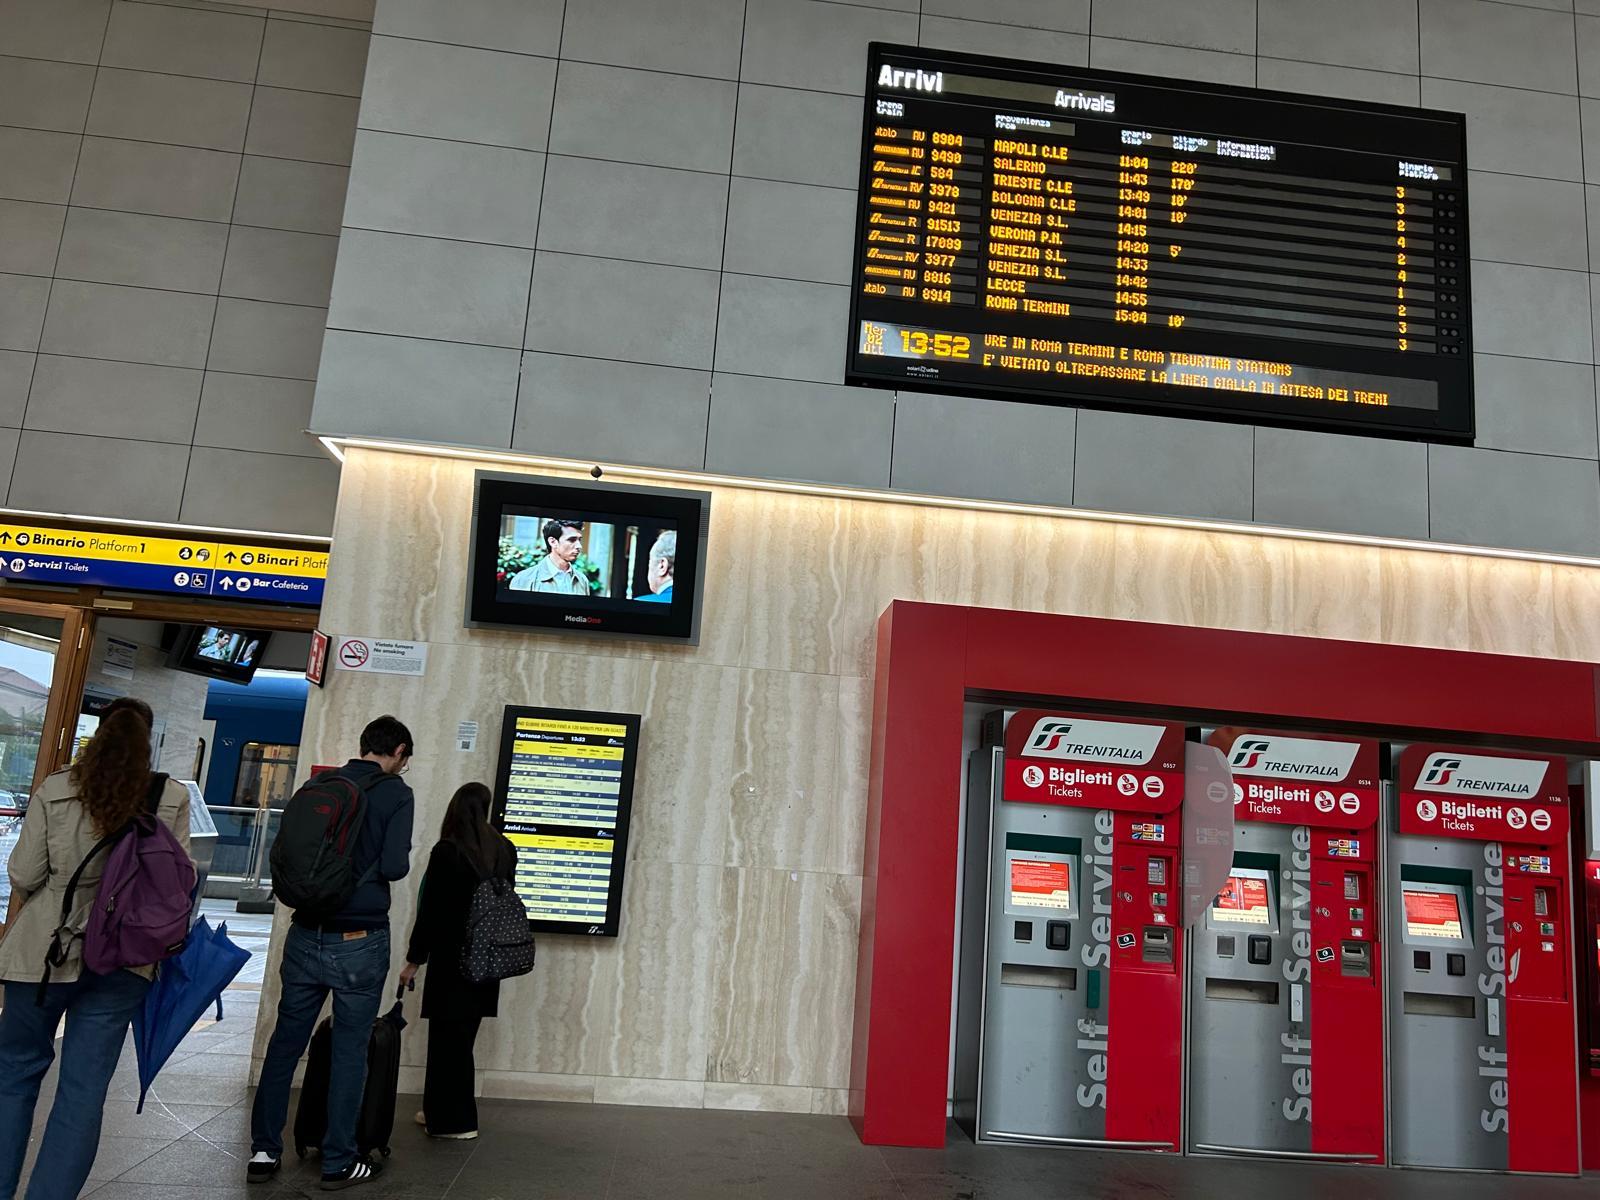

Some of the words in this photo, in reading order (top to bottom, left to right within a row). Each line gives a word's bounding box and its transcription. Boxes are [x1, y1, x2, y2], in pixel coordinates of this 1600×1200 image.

[878, 64, 943, 92] Arrivi
[1056, 90, 1116, 112] Arrivals
[1173, 135, 1208, 147] ritardo
[912, 130, 925, 141] AV
[994, 139, 1037, 156] NAPOLI
[1042, 145, 1068, 160] C.LE
[1120, 156, 1148, 169] 11:04
[1171, 162, 1197, 174] 220'
[1396, 187, 1405, 198] 3
[912, 148, 924, 158] AV
[931, 149, 961, 163] 9490
[994, 158, 1046, 173] SALERNO
[1120, 172, 1147, 186] 11:43
[1171, 178, 1194, 190] 170'
[1396, 203, 1405, 215] 3
[1399, 162, 1434, 173] binario
[910, 182, 924, 192] RV
[930, 184, 960, 198] 3978
[992, 191, 1044, 207] BOLOGNA
[1050, 198, 1076, 212] C.LE
[1118, 206, 1147, 219] 14:01
[1171, 212, 1187, 223] 10'
[1397, 236, 1405, 248] 4
[930, 166, 953, 180] 584
[994, 174, 1041, 191] TRIESTE
[1047, 181, 1073, 194] C.LE
[1120, 189, 1150, 203] 13:49
[1171, 195, 1187, 206] 10'
[1397, 220, 1405, 232] 2
[908, 199, 920, 209] AV
[928, 201, 955, 215] 9421
[991, 208, 1041, 225] VENEZIA
[1047, 216, 1069, 228] S.L.
[1118, 223, 1147, 236] 14:15
[1397, 253, 1406, 265] 2
[908, 217, 917, 227] R
[927, 218, 960, 232] 91513
[990, 225, 1036, 241] VERONA
[1041, 231, 1063, 244] P.N.
[1118, 240, 1148, 254] 14:20
[1398, 270, 1406, 282] 4
[905, 252, 920, 262] RV
[925, 253, 955, 267] 3977
[988, 260, 1039, 277] VENEZIA
[1044, 267, 1066, 280] S.L.
[1116, 274, 1147, 288] 14:42
[1398, 305, 1407, 316] 2
[907, 234, 916, 244] R
[926, 236, 962, 250] 17089
[989, 243, 1039, 259] VENEZIA
[1045, 250, 1067, 263] S.L.
[1117, 257, 1148, 271] 14:33
[1398, 287, 1404, 298] 1
[902, 286, 915, 297] AV
[922, 288, 951, 302] 8914
[986, 295, 1017, 310] ROMA
[1023, 299, 1070, 316] TERMINI
[1115, 310, 1147, 324] 15:04
[1168, 315, 1185, 327] 10'
[1399, 339, 1407, 351] 3
[904, 269, 916, 280] AV
[987, 277, 1026, 293] LECCE
[1116, 292, 1147, 306] 14:55
[1399, 322, 1407, 333] 3
[900, 329, 971, 359] 13:52
[984, 334, 1007, 348] URE
[1012, 337, 1026, 350] IN
[1031, 340, 1062, 353] ROMA
[1068, 342, 1115, 359] TERMINI
[1120, 347, 1129, 360] E
[1134, 349, 1165, 364] ROMA
[1170, 352, 1231, 371] TIBURTINA
[1237, 360, 1292, 376] STATIONS
[1000, 356, 1050, 372] VIETATO
[1055, 360, 1146, 382] OLTREPASSARE
[1152, 370, 1167, 384] LA
[1173, 373, 1208, 388] LINEA
[1214, 377, 1256, 393] GIALLA
[1262, 380, 1275, 394] IN
[1280, 383, 1323, 400] ATTESA
[1328, 387, 1349, 402] DEI
[1354, 391, 1388, 406] TRENI
[32, 533, 85, 549] Binario
[89, 538, 137, 553] Platform
[140, 543, 146, 554] 1
[257, 553, 299, 567] Binari
[27, 558, 63, 570] Servizi
[64, 562, 89, 572] Toilets
[253, 578, 271, 588] Bar
[272, 580, 309, 591] Cafeteria
[1066, 743, 1143, 760] TRENITALIA
[1264, 762, 1339, 776] TRENITALIA
[1048, 784, 1083, 798] Tickets
[1049, 767, 1113, 785] Biglietti
[1248, 784, 1310, 802] Biglietti
[1456, 779, 1529, 793] TRENITALIA
[1248, 801, 1281, 814] Tickets
[1441, 817, 1475, 831] Tickets
[1442, 801, 1502, 819] Biglietti
[1081, 809, 1114, 968] Service
[1283, 826, 1310, 983] Service
[1477, 842, 1505, 997] Service
[1077, 1019, 1108, 1109] Self
[1282, 1033, 1311, 1122] Self
[1478, 1046, 1508, 1133] Self
